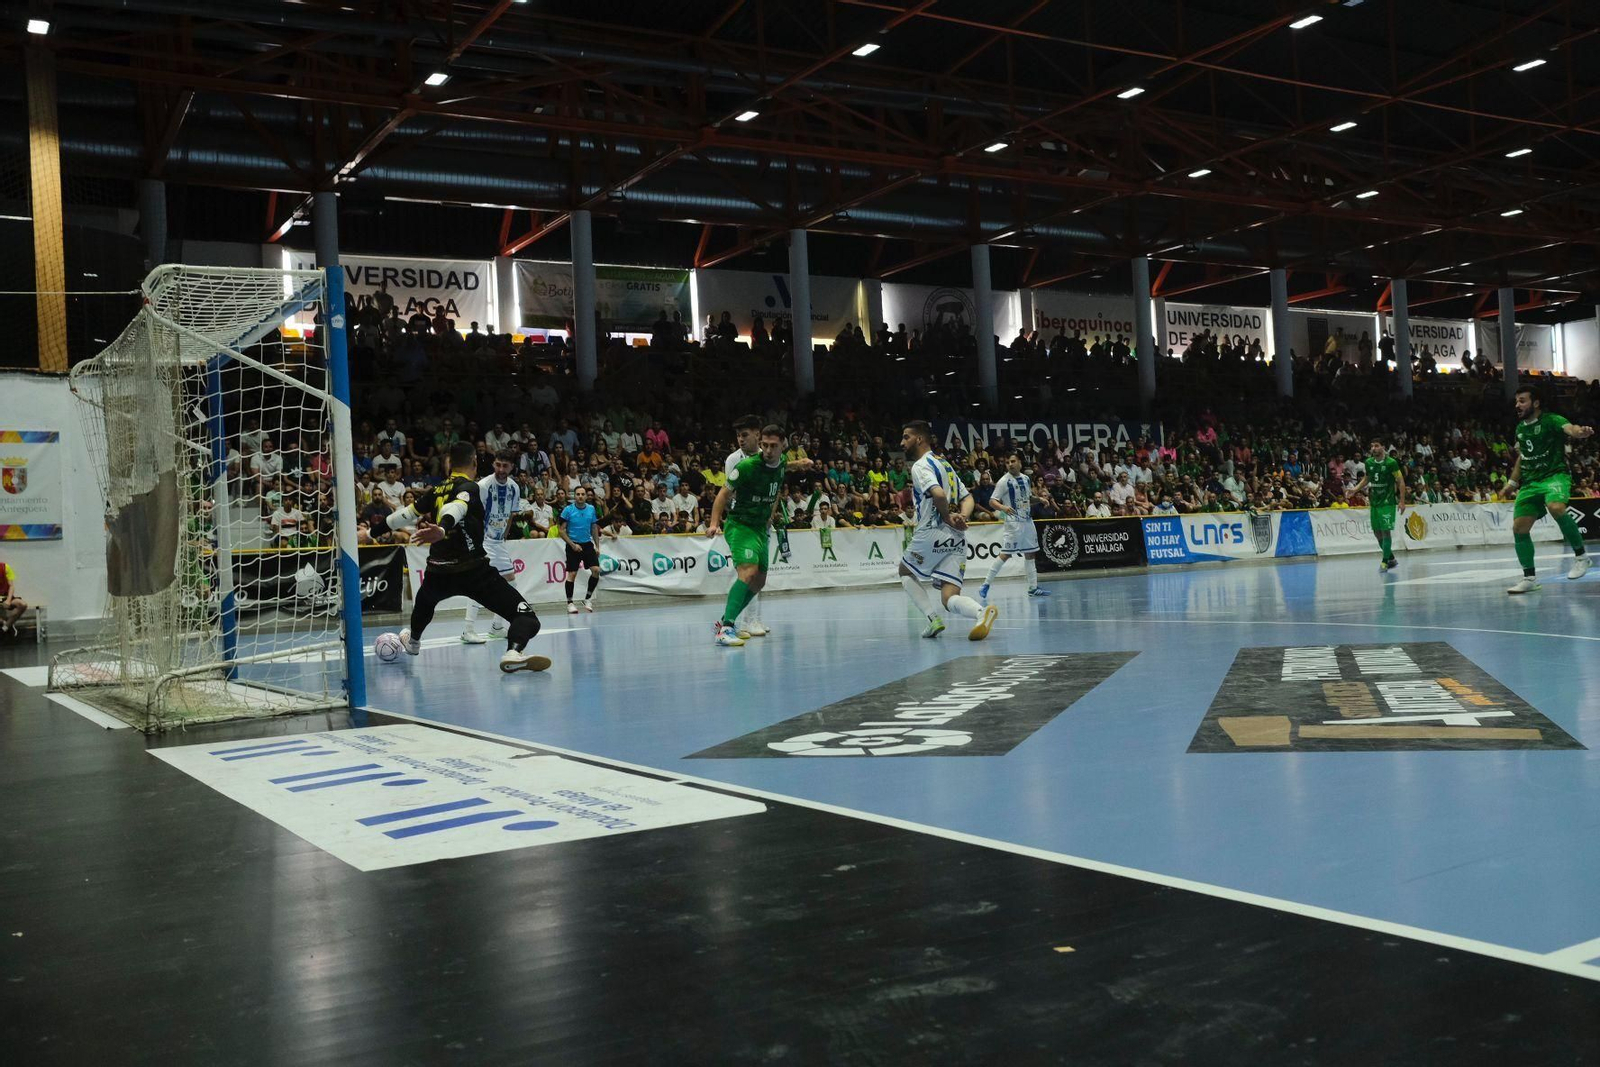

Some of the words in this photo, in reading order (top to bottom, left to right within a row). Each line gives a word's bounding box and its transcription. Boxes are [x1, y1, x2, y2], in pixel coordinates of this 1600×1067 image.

[627, 282, 660, 291] GRATIS
[1035, 309, 1132, 335] iberoquinoa
[1167, 310, 1261, 329] UNIVERSIDAD
[1169, 332, 1187, 345] DE
[1526, 439, 1534, 452] 9
[1145, 522, 1161, 533] SIN
[1162, 522, 1171, 532] TI
[1083, 532, 1129, 543] UNIVERSIDAD
[1148, 536, 1160, 546] NO
[1162, 535, 1180, 545] HAY
[1085, 545, 1095, 553] DE
[1096, 542, 1124, 553] MÁLAGA
[1151, 547, 1185, 559] FUTSAL
[654, 556, 696, 573] anp
